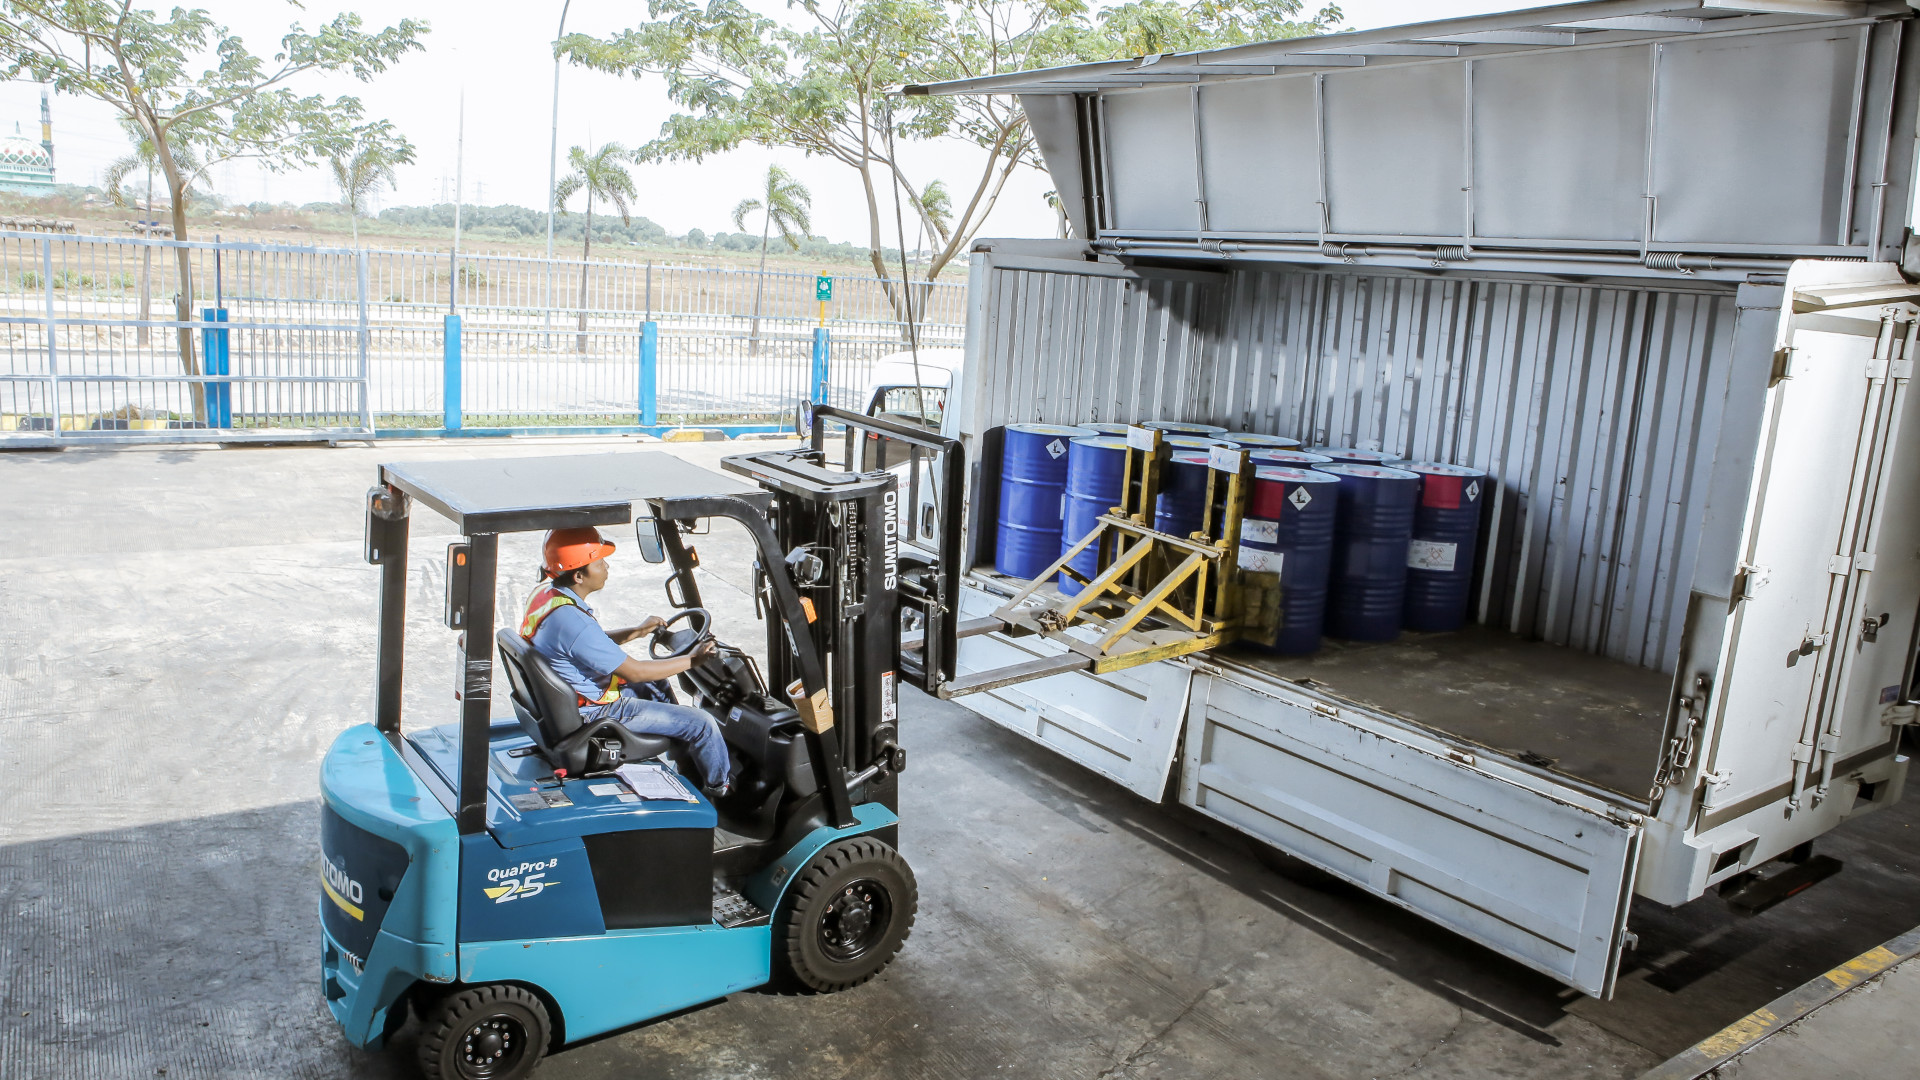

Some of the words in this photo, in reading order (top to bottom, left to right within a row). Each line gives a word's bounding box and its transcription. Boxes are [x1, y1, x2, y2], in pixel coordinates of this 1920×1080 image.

[884, 490, 897, 591] SUMITOMO
[487, 858, 558, 882] QuaPro-B
[495, 872, 546, 904] 25
